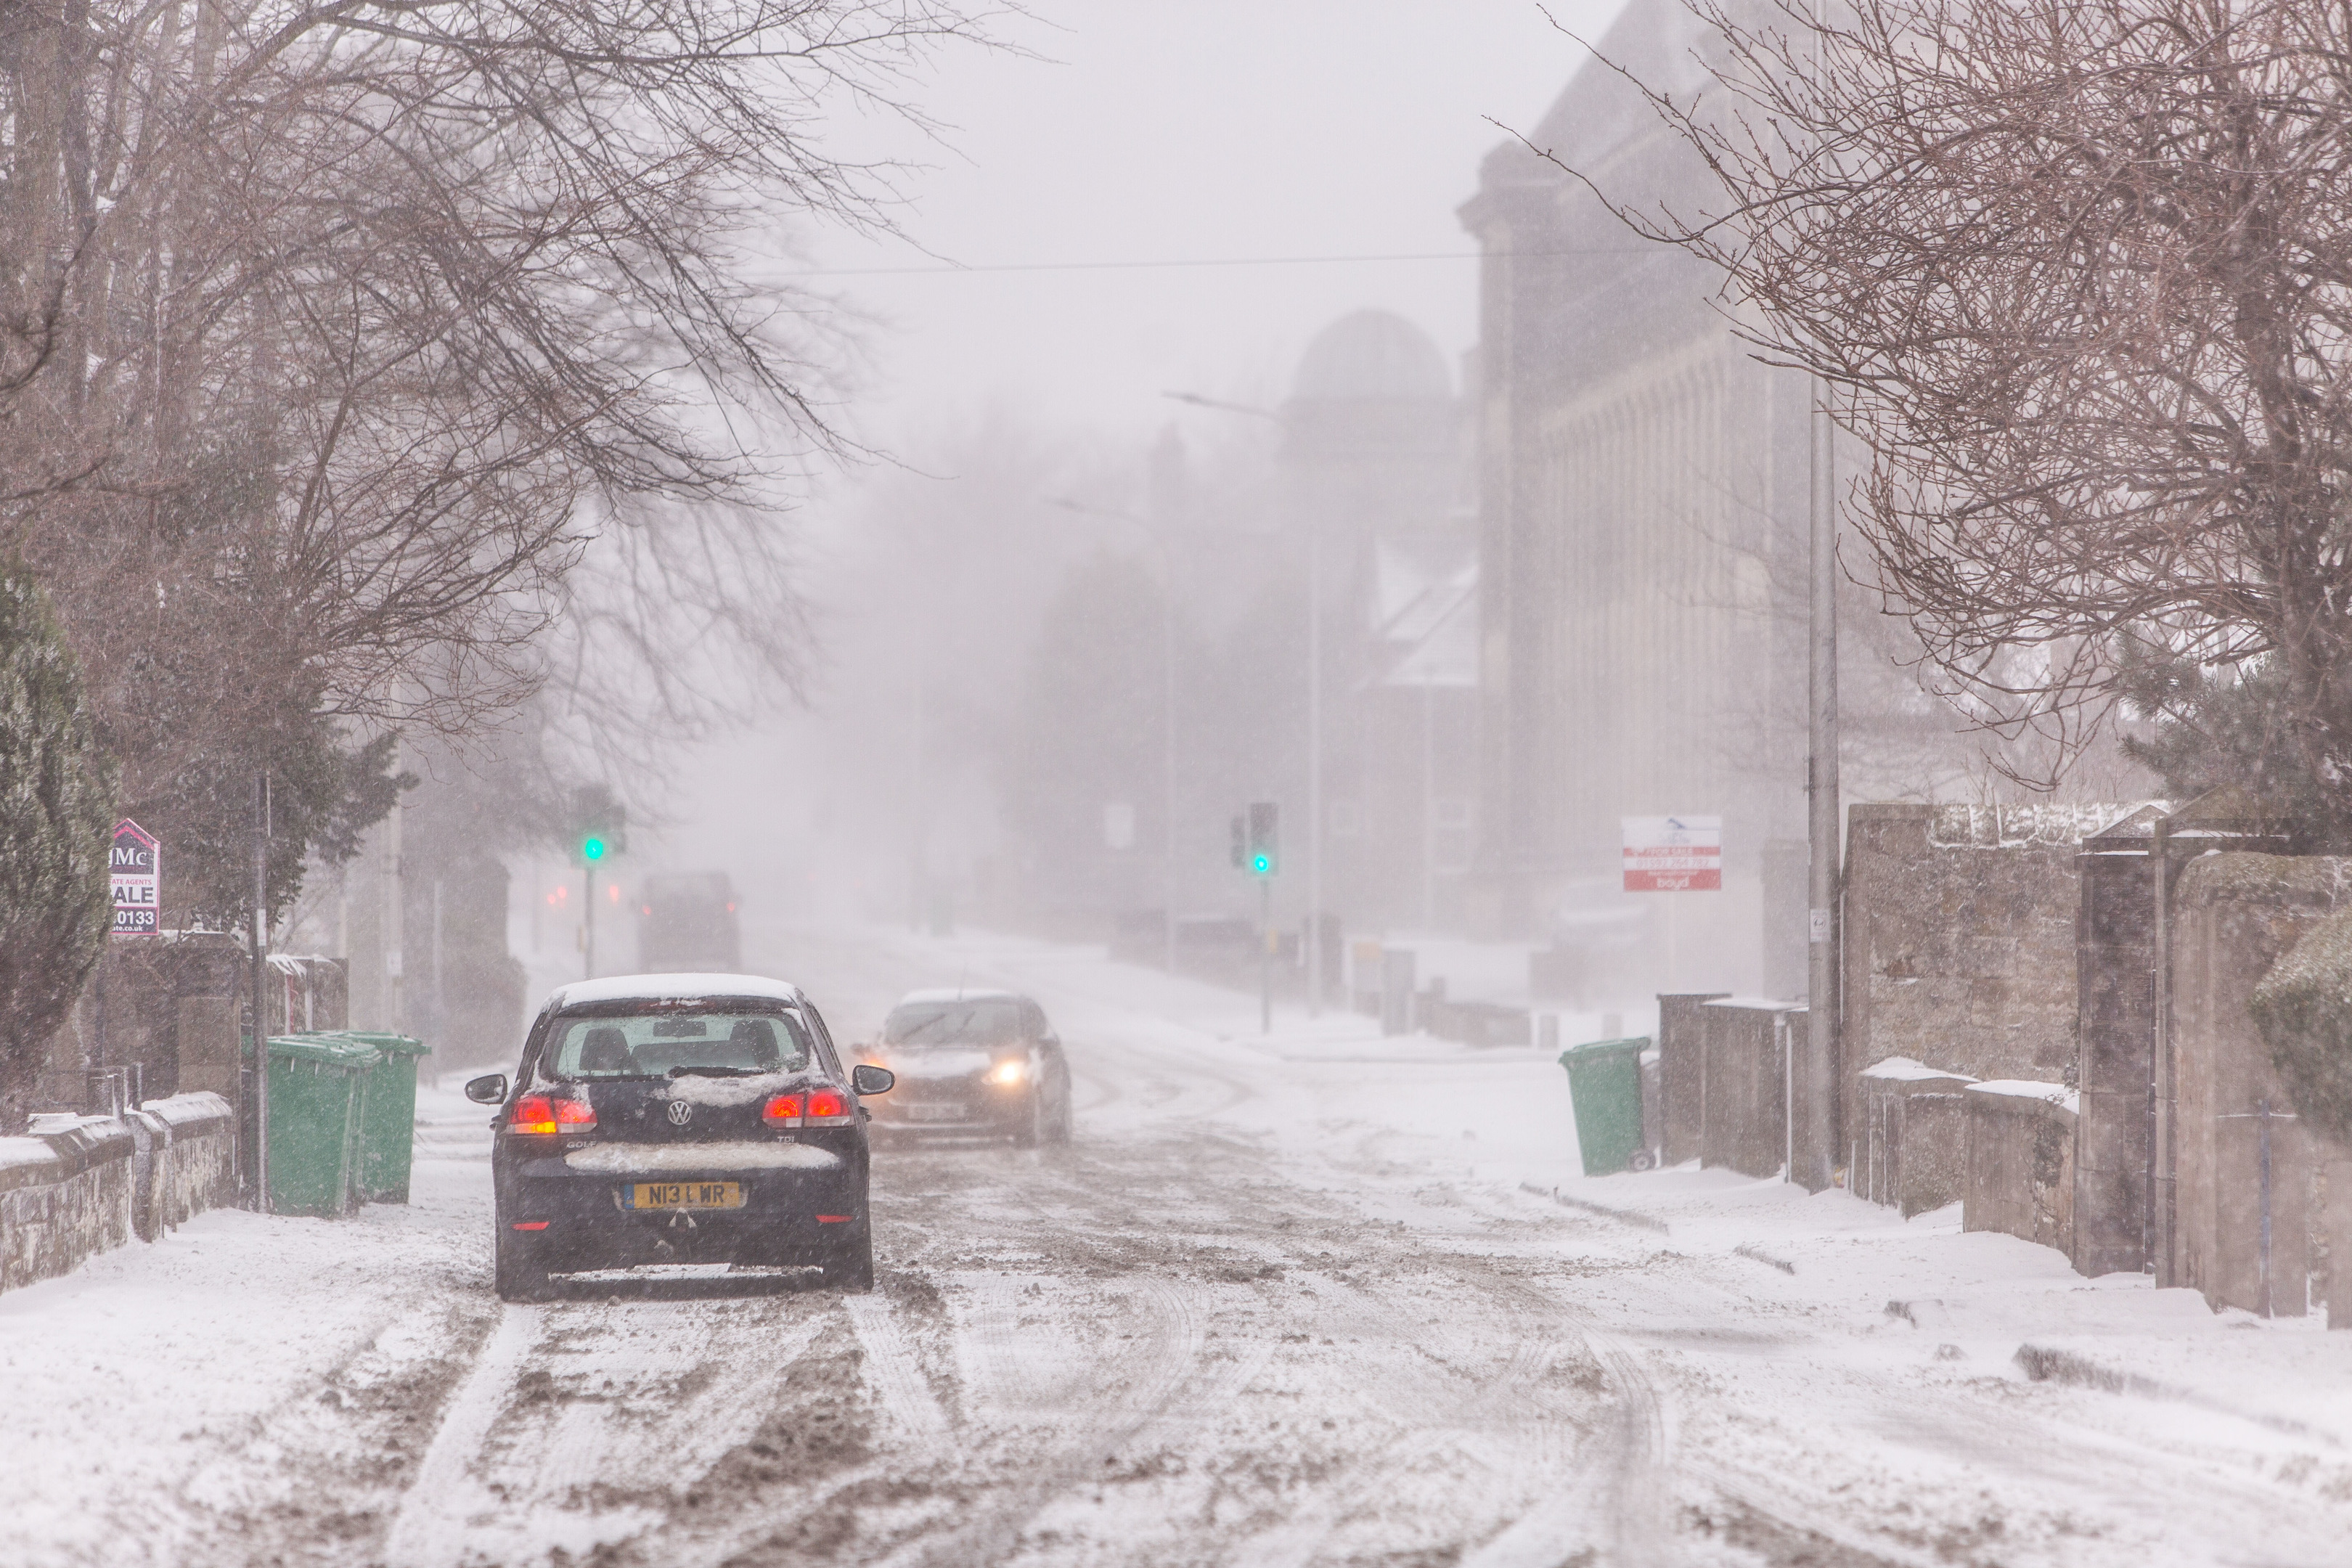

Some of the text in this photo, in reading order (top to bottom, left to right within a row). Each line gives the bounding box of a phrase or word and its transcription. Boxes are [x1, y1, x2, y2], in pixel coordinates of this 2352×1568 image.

[113, 886, 154, 904] ALE
[113, 910, 155, 926] 0133
[566, 1140, 597, 1149] GOLF
